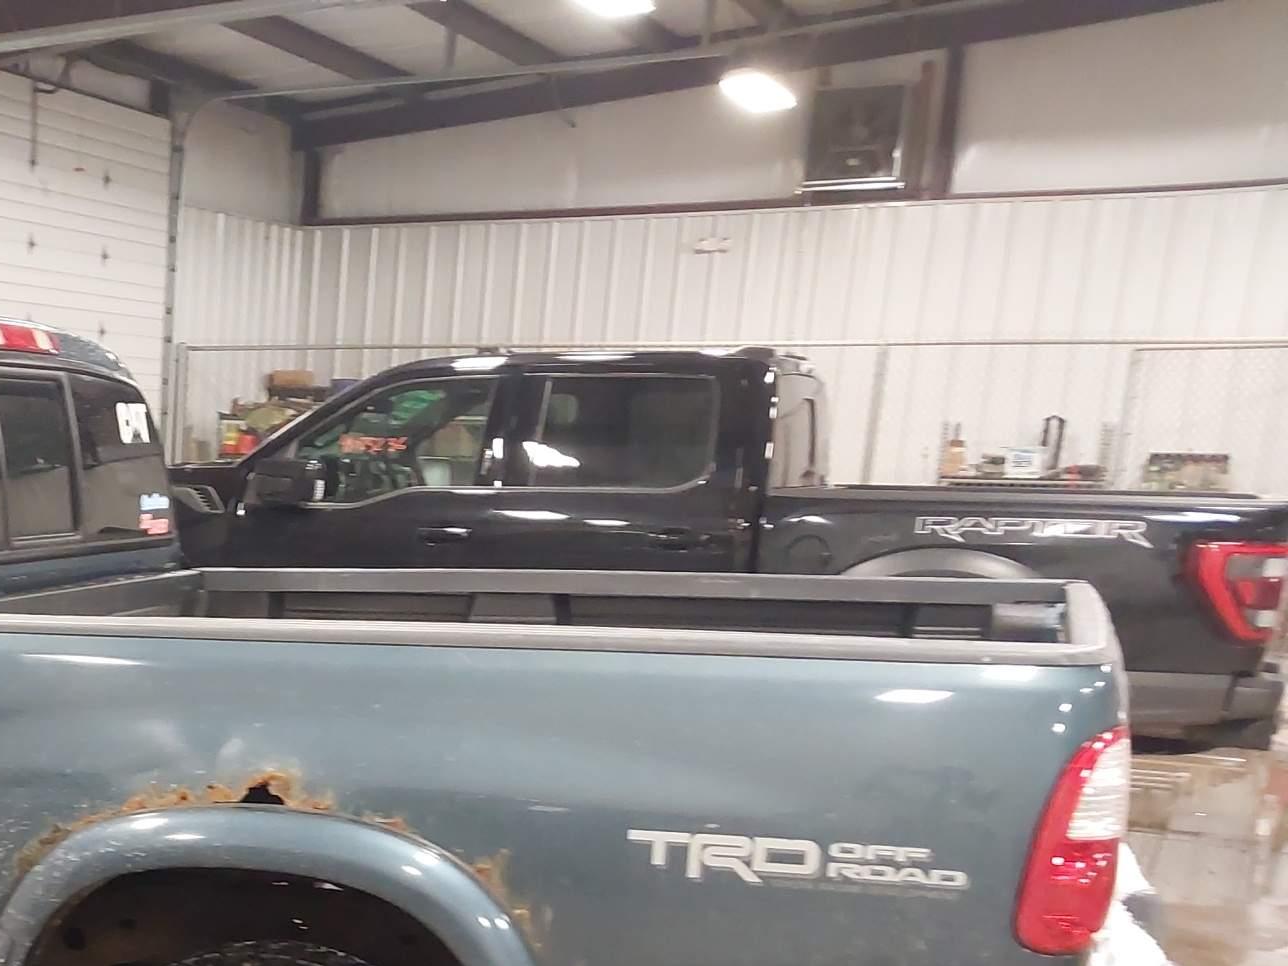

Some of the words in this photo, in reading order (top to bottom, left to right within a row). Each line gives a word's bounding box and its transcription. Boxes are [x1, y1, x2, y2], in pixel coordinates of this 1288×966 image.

[914, 516, 1154, 548] RAPTOR
[626, 829, 821, 883] TRD
[828, 842, 932, 863] OFF
[827, 862, 968, 888] ROAD
